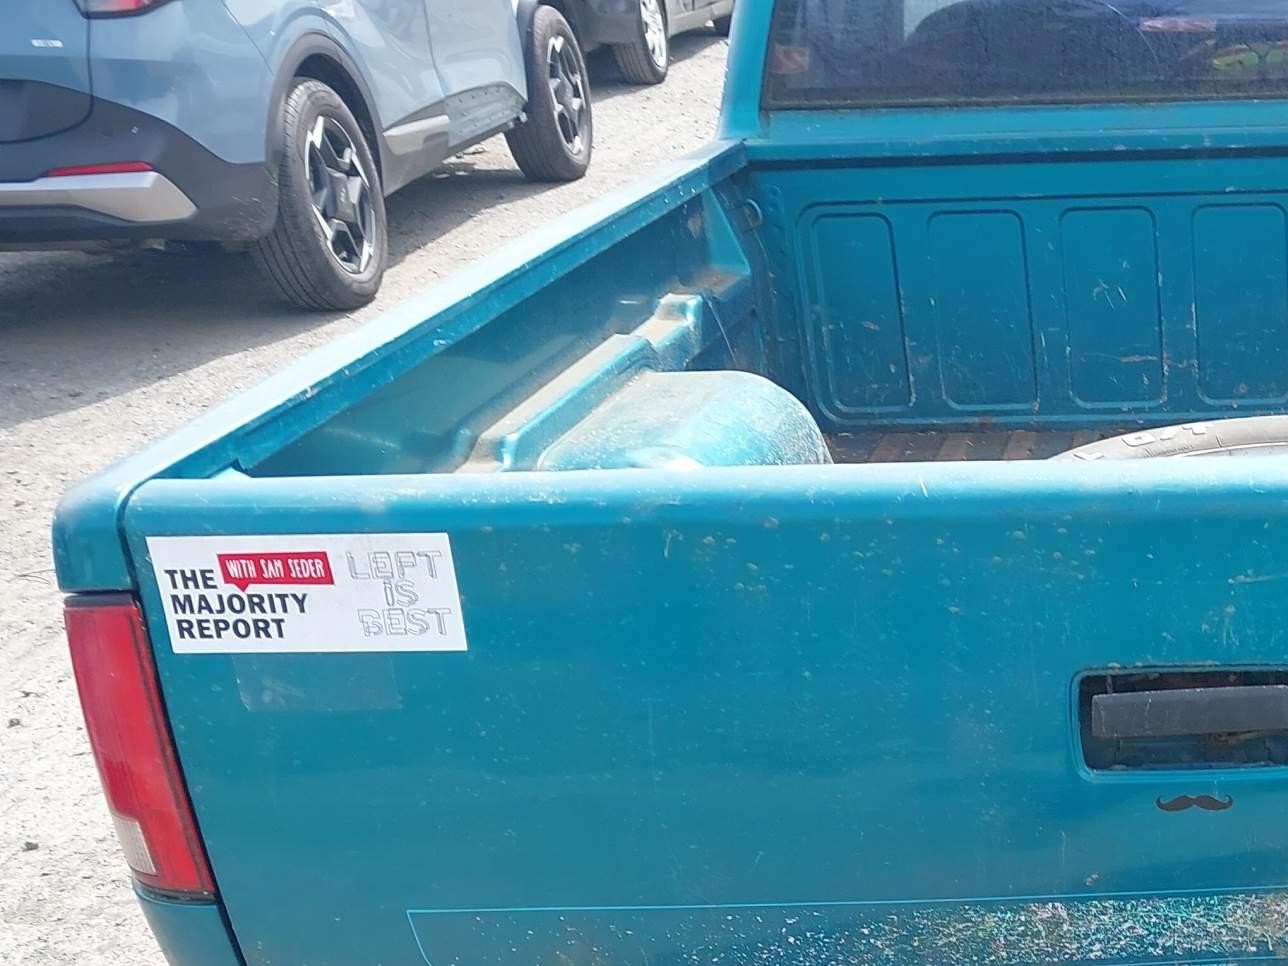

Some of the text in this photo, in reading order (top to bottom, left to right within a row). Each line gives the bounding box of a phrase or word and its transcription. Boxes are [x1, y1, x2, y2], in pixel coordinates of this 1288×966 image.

[225, 558, 326, 579] WITH SAM SEDER
[345, 550, 442, 579] LEFT
[164, 569, 218, 590] THE
[170, 593, 308, 615] MAJORITY
[176, 618, 286, 640] REPORT
[357, 607, 452, 637] BEST
